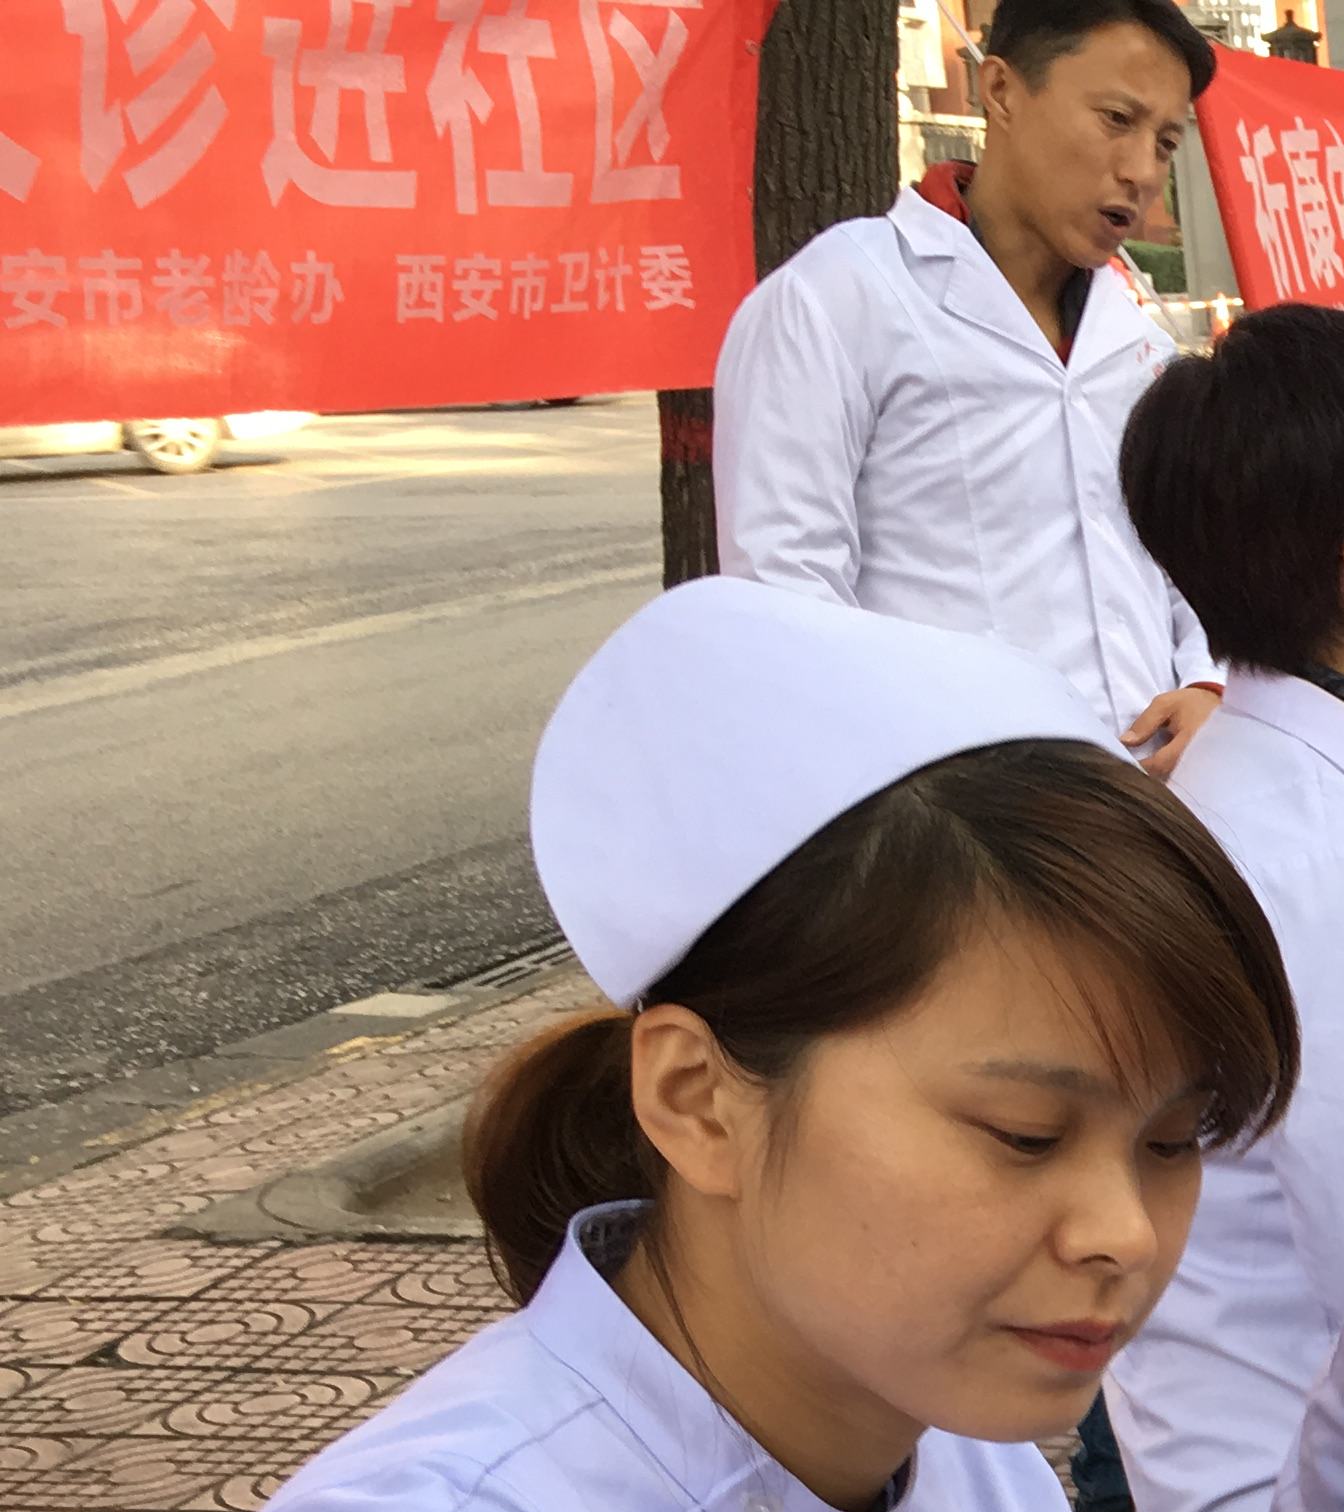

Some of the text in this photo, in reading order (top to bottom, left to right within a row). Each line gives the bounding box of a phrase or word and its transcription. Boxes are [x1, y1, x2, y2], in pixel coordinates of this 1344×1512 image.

[0, 0, 690, 214] 诊进社区
[2, 244, 696, 329] 安市老龄办 西安市卫计委
